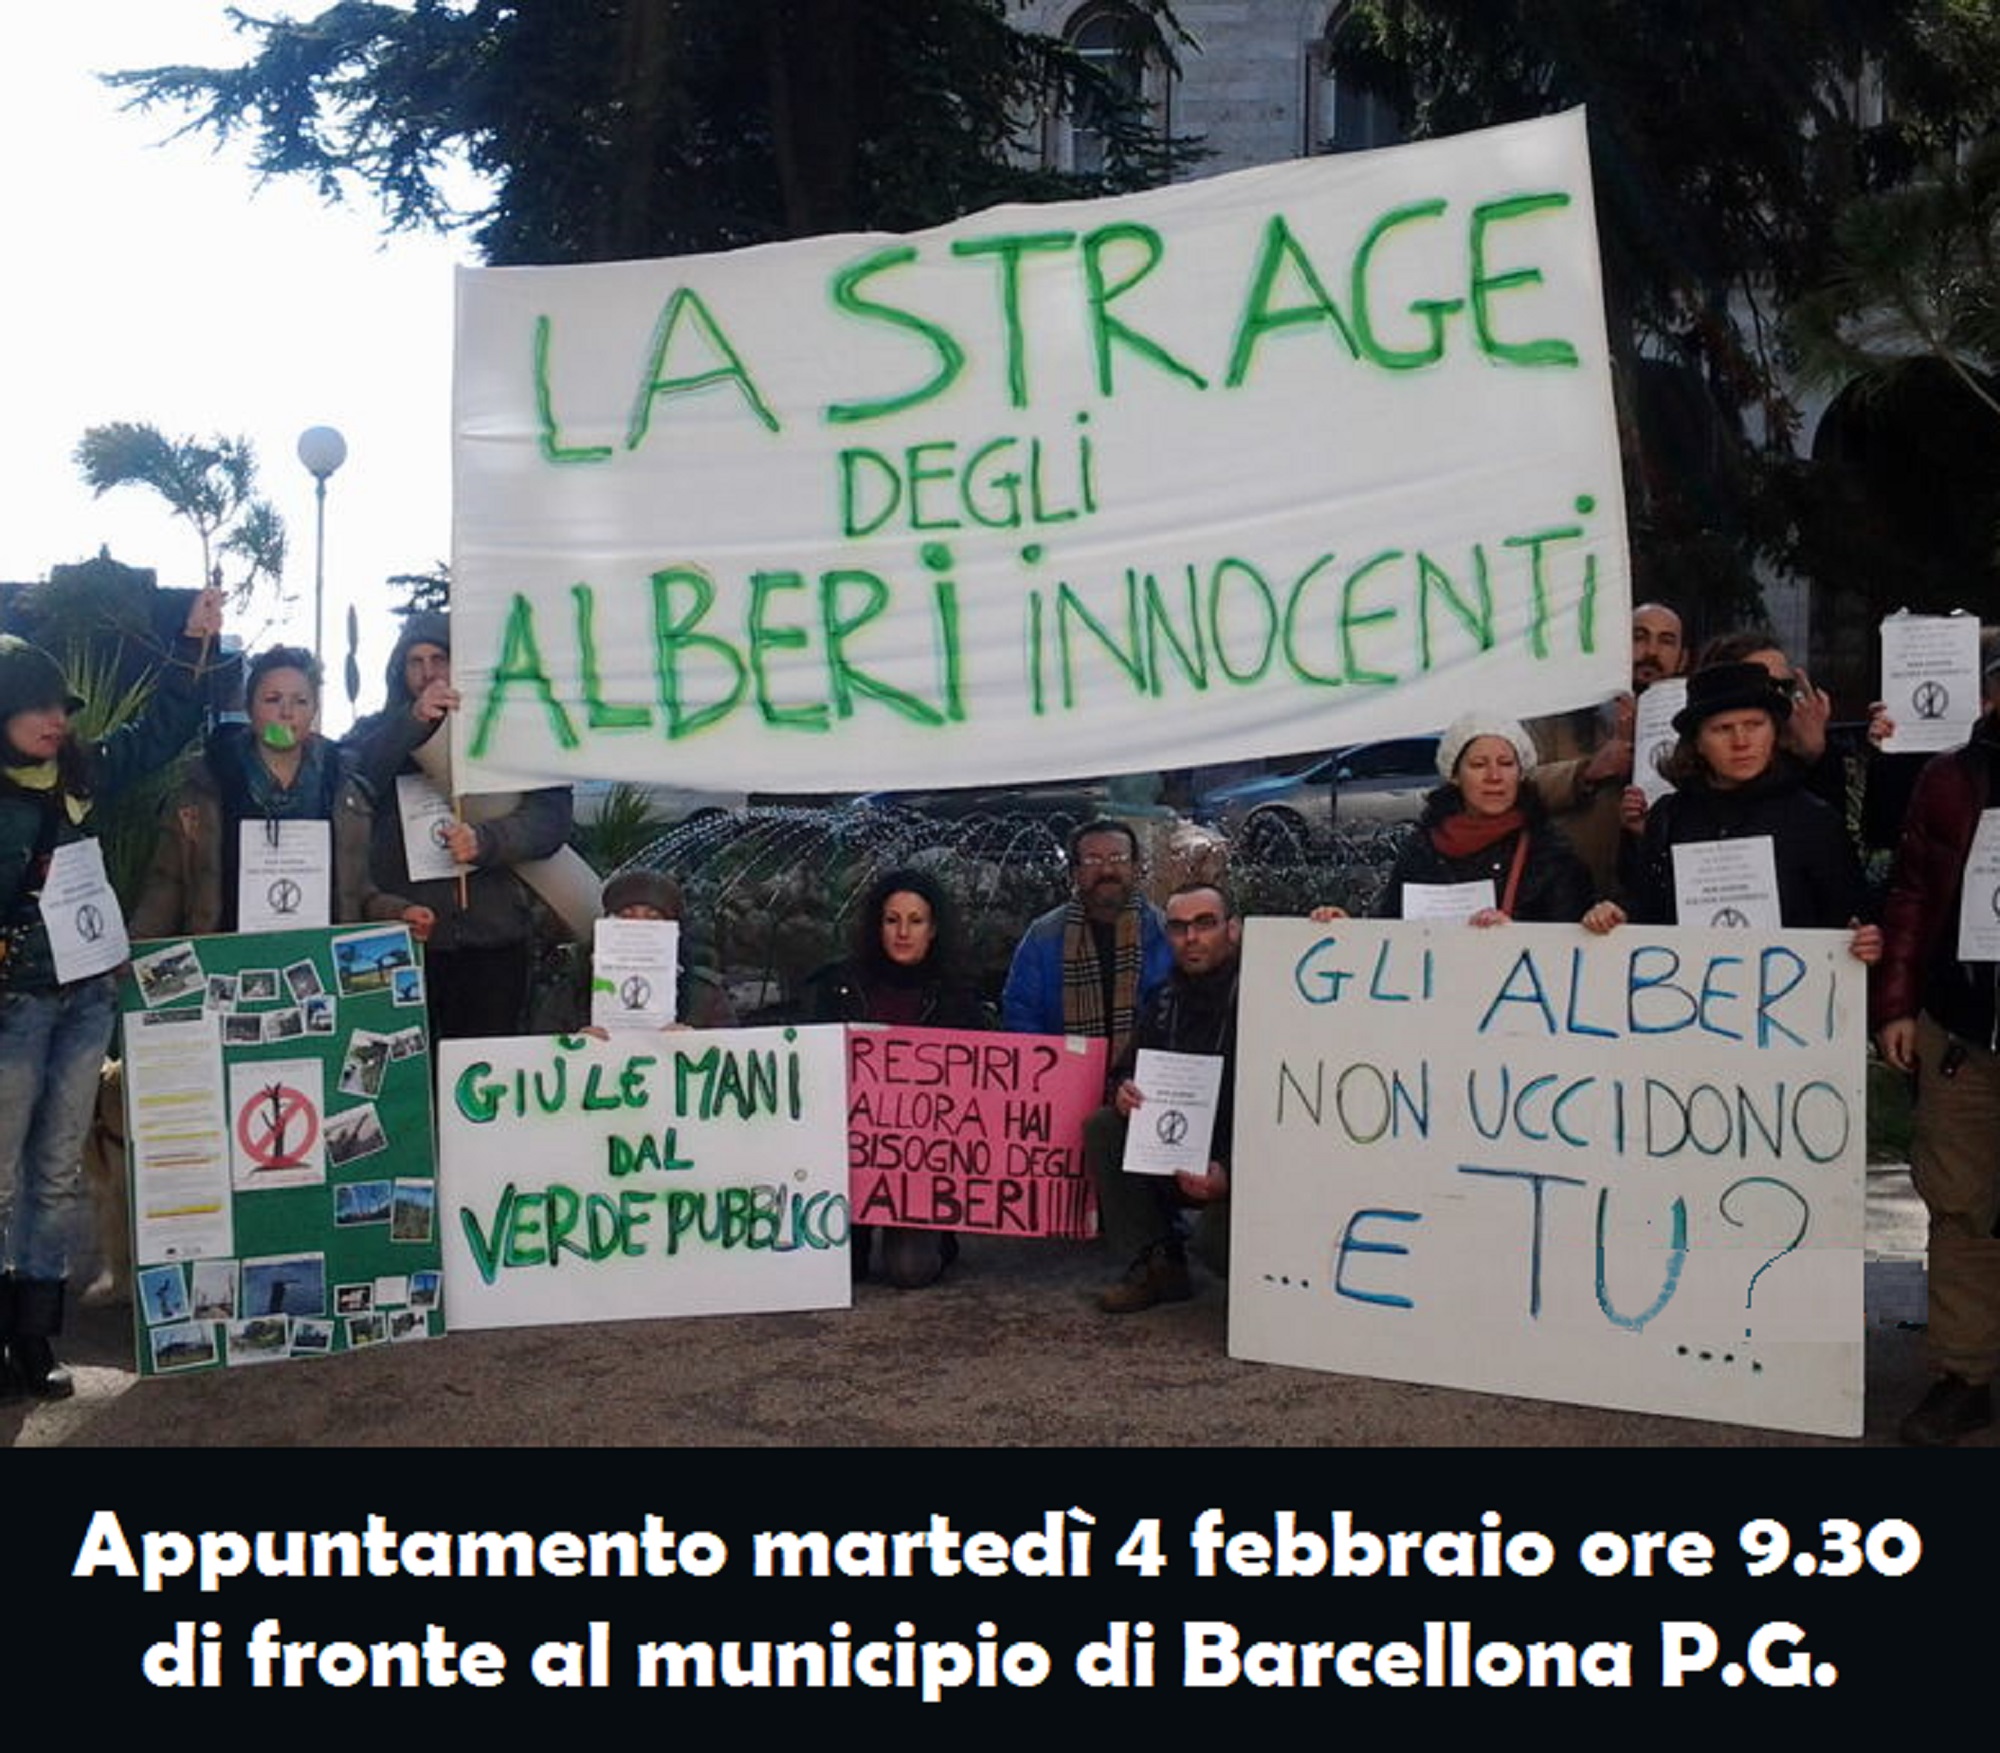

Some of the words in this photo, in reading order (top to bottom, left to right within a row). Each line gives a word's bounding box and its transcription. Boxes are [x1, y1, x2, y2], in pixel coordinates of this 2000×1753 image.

[535, 286, 779, 463] LA
[825, 192, 1580, 423] STRAGE
[582, 1056, 657, 1111] LE
[848, 1091, 988, 1139] ALLORA
[1004, 1100, 1051, 1142] HAI
[1276, 1060, 1429, 1145] NON
[1468, 1064, 1850, 1164] UCCIDONO
[607, 1127, 695, 1176] DAL
[848, 1130, 992, 1176] BISOGNO
[1006, 1143, 1086, 1179] DEGLI
[459, 1182, 656, 1285] VERDE
